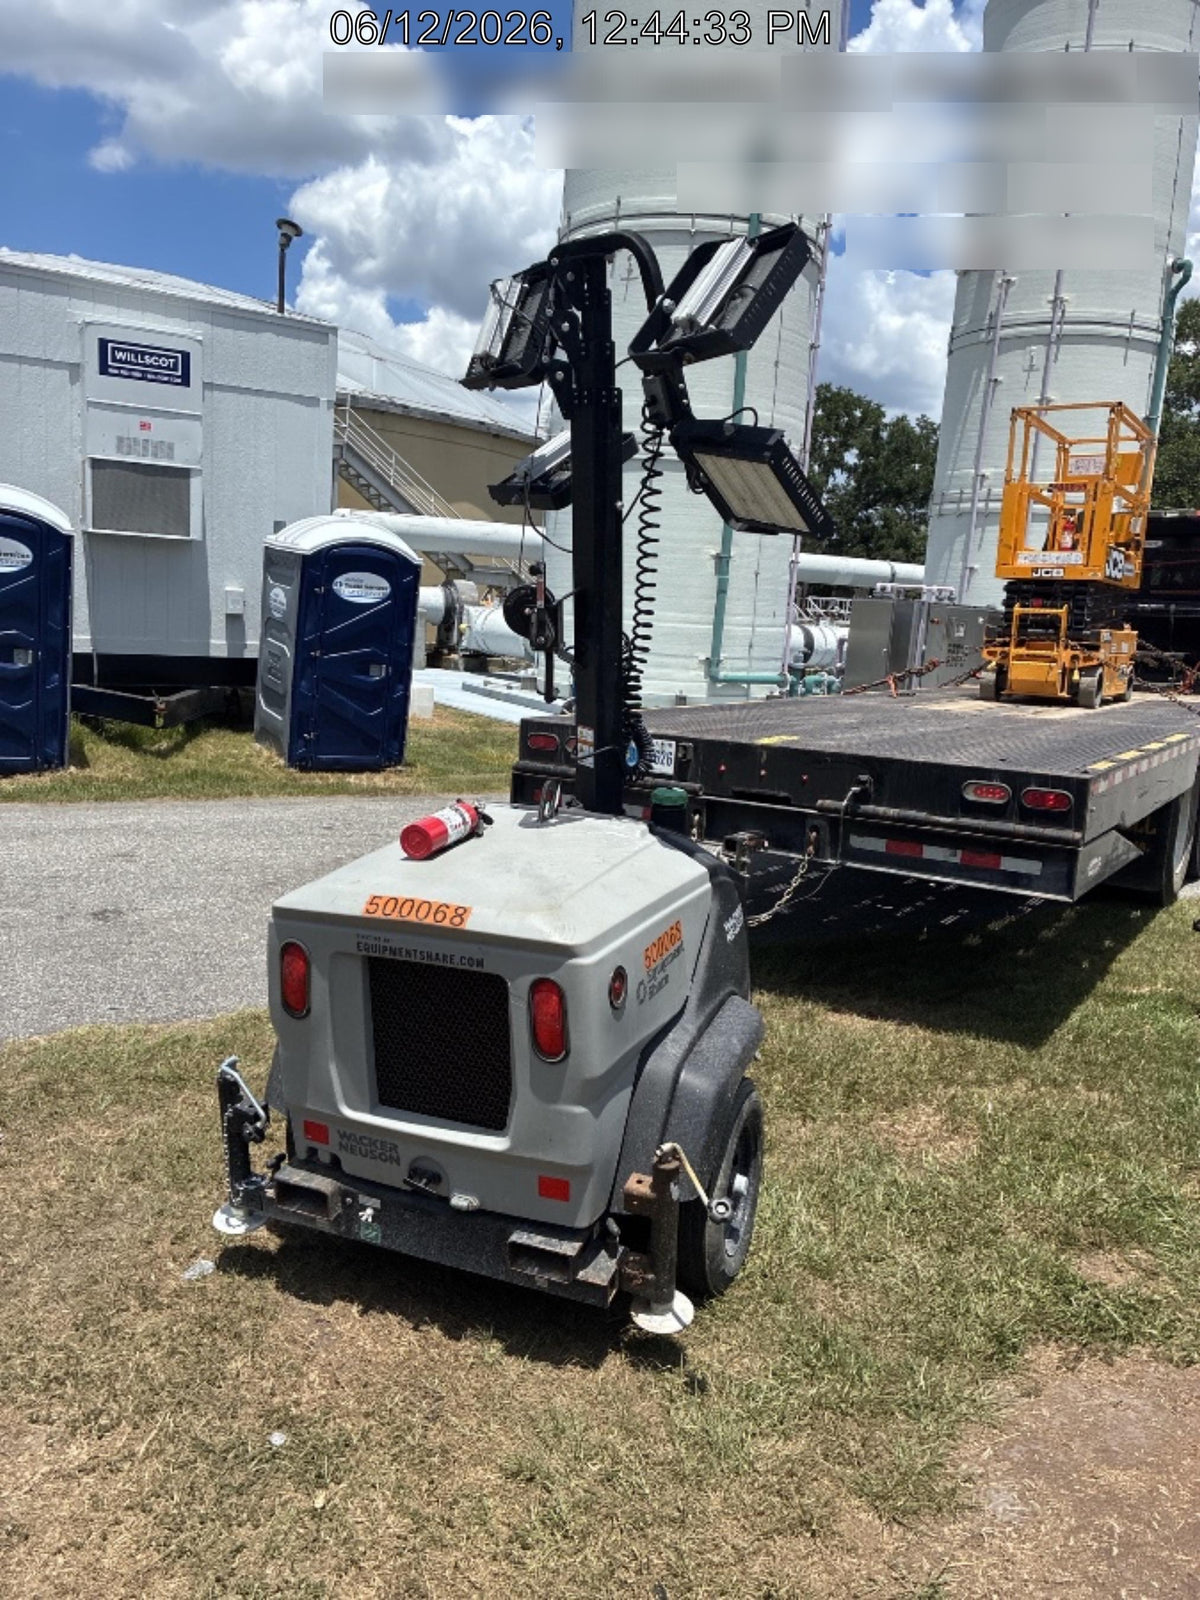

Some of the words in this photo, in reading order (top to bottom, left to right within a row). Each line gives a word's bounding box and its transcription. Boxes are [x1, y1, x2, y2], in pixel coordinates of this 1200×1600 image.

[114, 350, 176, 369] WILLSCOT
[365, 895, 468, 927] 500068
[356, 941, 484, 969] EQUIPMENTSHARE.COM
[337, 1130, 399, 1154] WACKER
[338, 1141, 401, 1167] NEUSON
